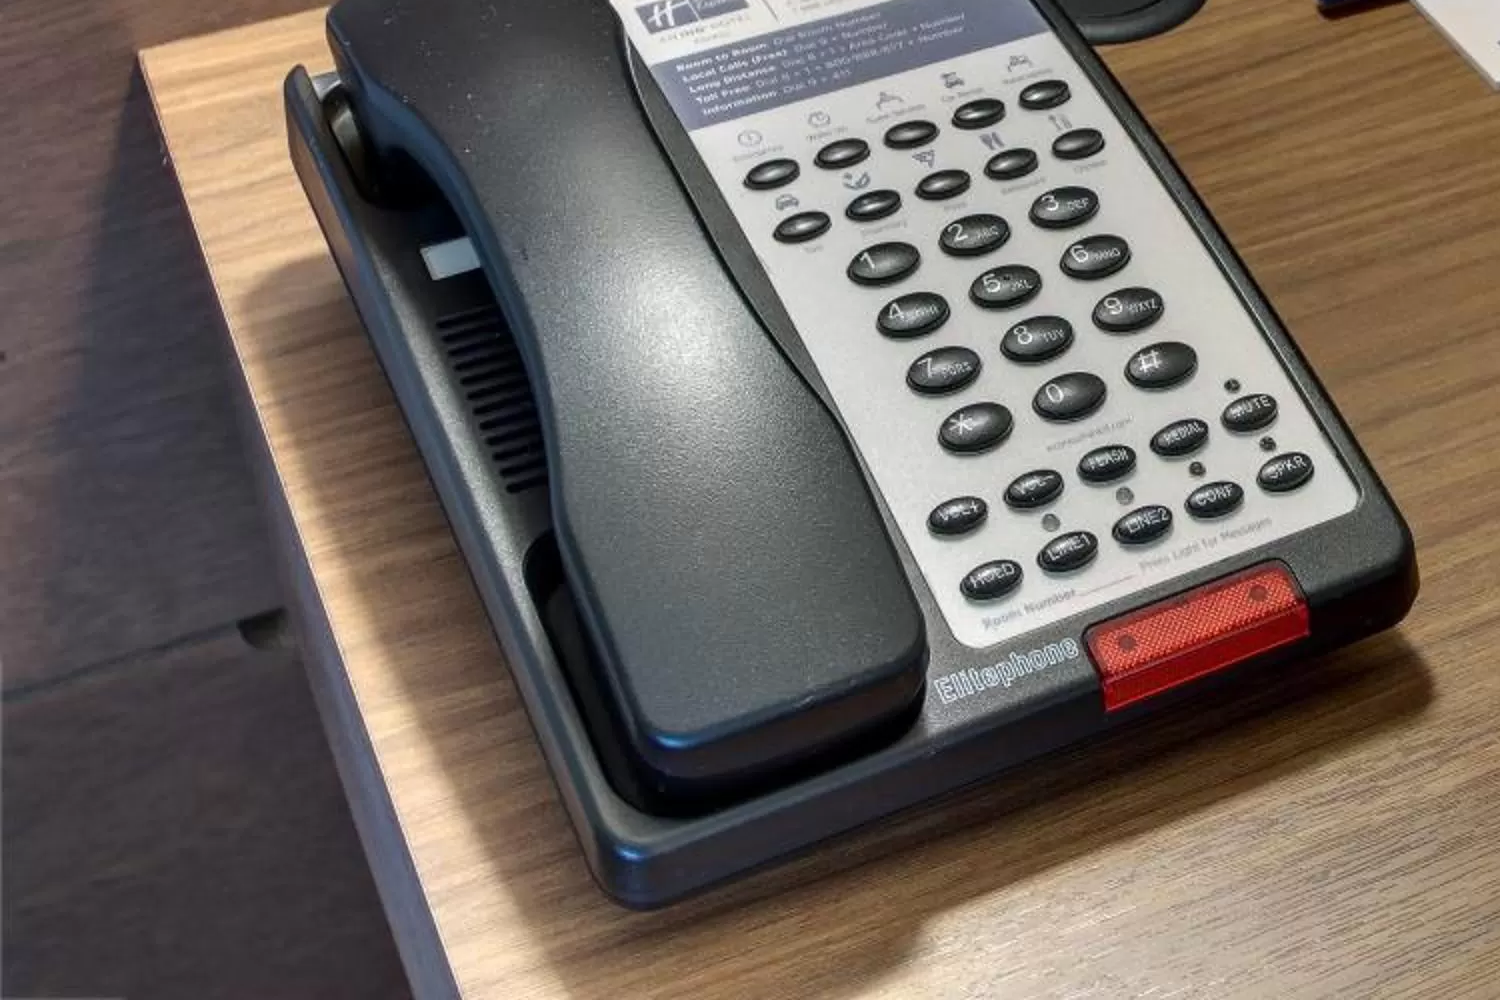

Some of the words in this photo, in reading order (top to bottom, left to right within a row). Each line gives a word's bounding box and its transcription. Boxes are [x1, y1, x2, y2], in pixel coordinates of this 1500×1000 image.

[676, 57, 713, 73] Room
[715, 53, 729, 63] to
[835, 11, 881, 28] Number
[682, 67, 717, 83] Local
[719, 60, 749, 74] Calls
[840, 23, 888, 39] Number
[688, 80, 721, 95] Long
[920, 11, 965, 30] Number
[695, 91, 719, 104] Toll
[1041, 194, 1059, 212] 3
[1067, 196, 1089, 210] DEF
[947, 223, 968, 242] 2
[975, 224, 999, 240] ABC
[860, 252, 875, 270] 1
[1070, 244, 1088, 263] 6
[982, 273, 1001, 293] 5
[1011, 279, 1033, 292] JKL
[888, 302, 904, 320] 4
[1103, 297, 1123, 315] 9
[1013, 325, 1032, 345] 8
[1043, 328, 1066, 343] TUV
[918, 357, 935, 378] 7
[1046, 383, 1064, 403] 0
[1230, 395, 1272, 418] MUTE
[1162, 421, 1205, 445] REDIAL
[1087, 447, 1129, 469] FLASH
[1268, 455, 1308, 479] SPKR
[1195, 483, 1234, 506] CONF
[1125, 506, 1169, 534] LINE2
[1047, 533, 1091, 561] LINE1
[1139, 554, 1170, 573] Press
[1172, 541, 1200, 562] Light
[1201, 536, 1218, 551] for
[968, 562, 1016, 588] HOLD
[982, 610, 1023, 631] Room
[1023, 588, 1076, 614] Number
[933, 636, 1080, 705] Elitephone
